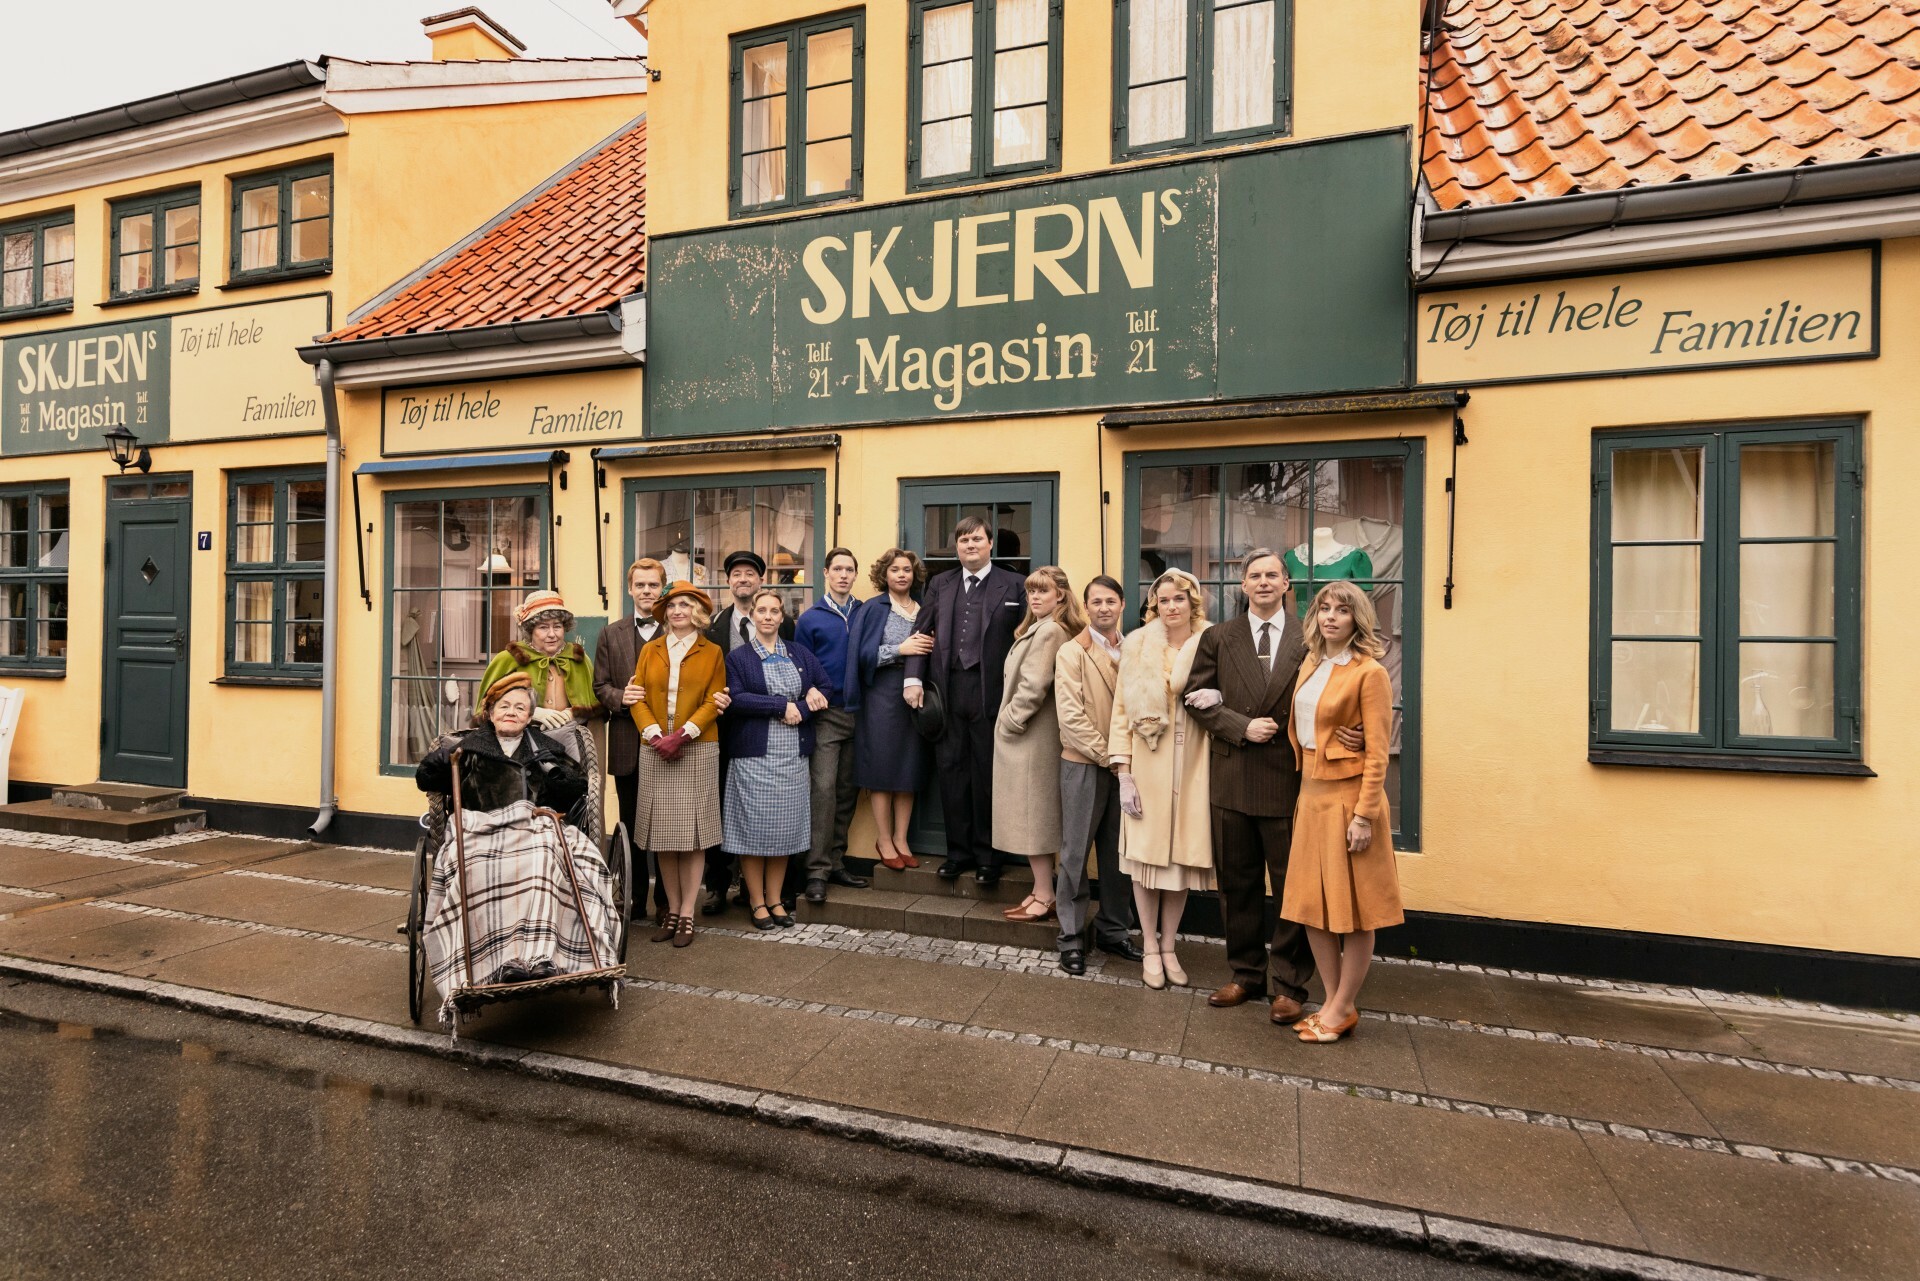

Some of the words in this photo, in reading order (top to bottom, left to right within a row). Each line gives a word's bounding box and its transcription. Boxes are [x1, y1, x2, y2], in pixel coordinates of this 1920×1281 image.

[1126, 309, 1160, 334] Telf.
[1426, 302, 1485, 350] Tøj
[1496, 293, 1540, 337] til
[1548, 285, 1643, 333] hele
[1650, 300, 1862, 354] Familien
[180, 327, 204, 357] Tøj
[206, 322, 224, 349] til
[227, 318, 264, 347] hele
[805, 341, 833, 363] Telf.
[855, 322, 1097, 411] Magasin
[1126, 337, 1157, 375] 21
[807, 366, 832, 399] 21
[38, 395, 127, 441] Magasin
[136, 405, 148, 423] 21
[242, 392, 317, 421] Familien
[400, 396, 429, 430] Tøj
[432, 393, 454, 422] til
[456, 389, 501, 421] hele
[528, 401, 623, 435] Familien
[20, 416, 30, 433] 21
[200, 533, 209, 549] 7
